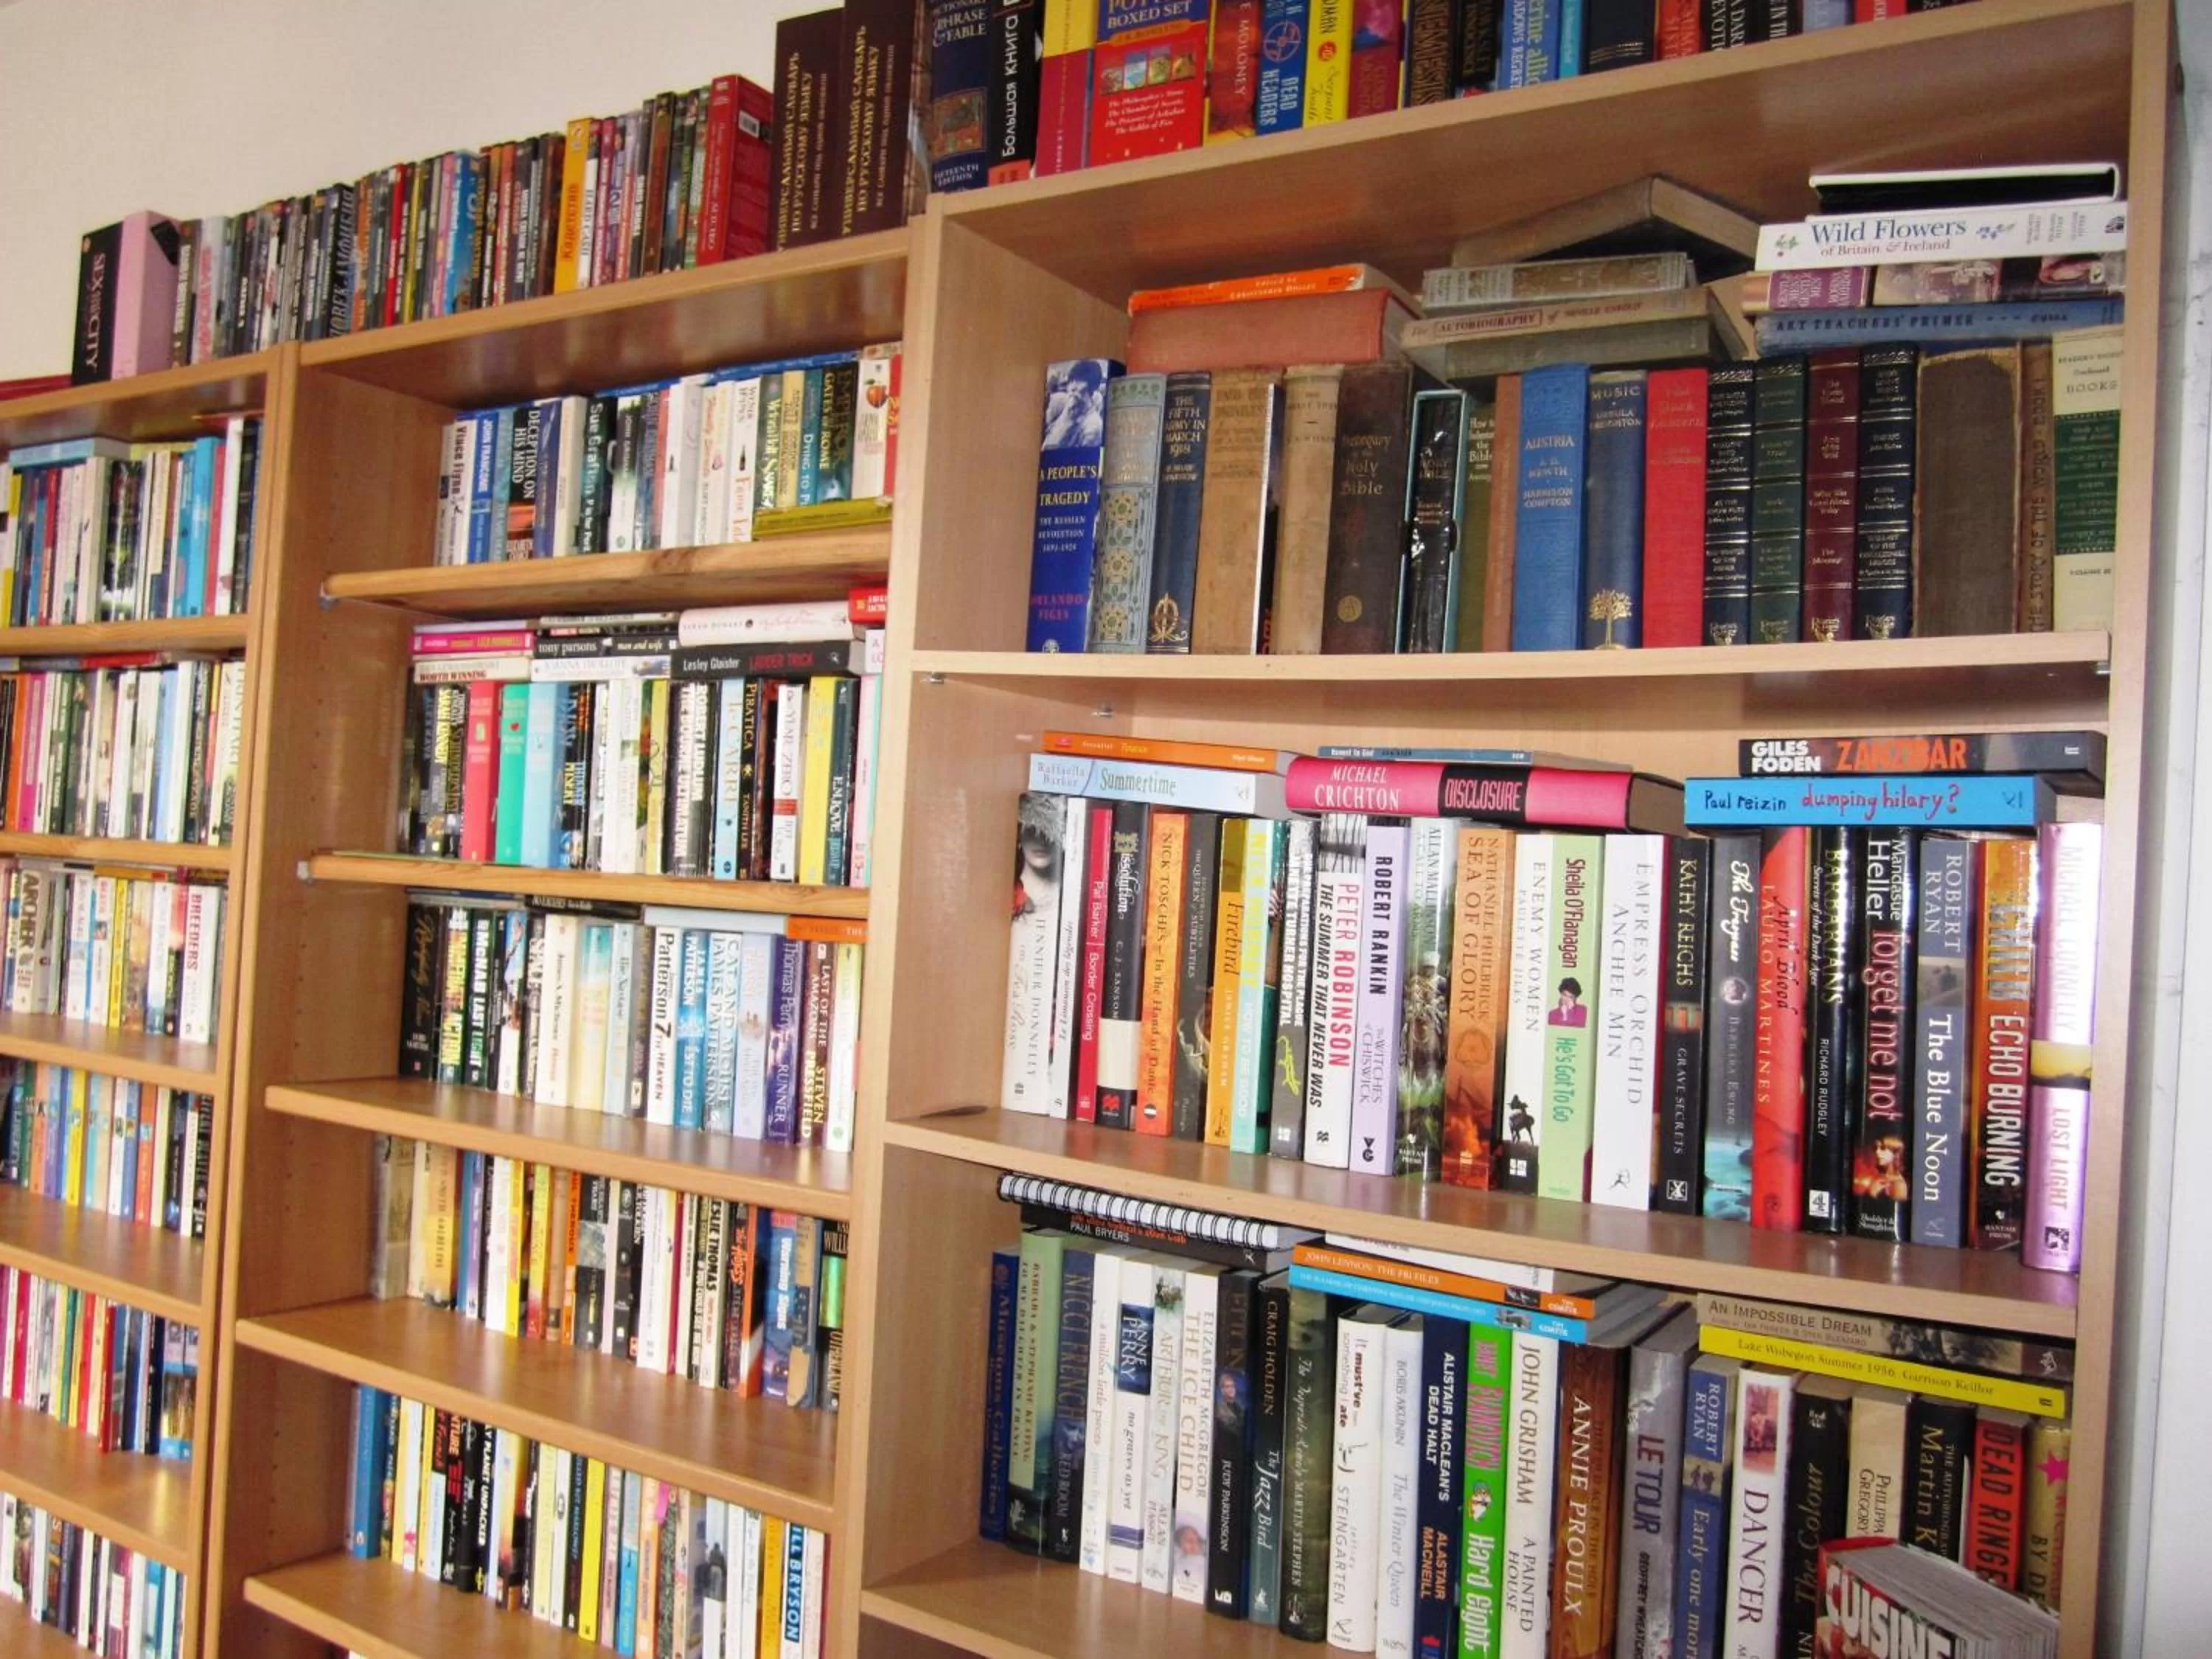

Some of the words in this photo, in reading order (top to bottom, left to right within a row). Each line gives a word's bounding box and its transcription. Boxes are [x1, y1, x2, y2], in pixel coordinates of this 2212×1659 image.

[1107, 7, 1161, 29] BOXED
[1164, 1, 1192, 23] SET
[1234, 20, 1250, 96] MOLONEY
[1278, 77, 1299, 111] DEAD
[1810, 218, 1865, 244] Wild
[1875, 216, 1967, 240] Flowers
[1820, 244, 1834, 256] of
[1837, 243, 1879, 256] Britain
[1904, 238, 1951, 251] Ireland
[590, 404, 602, 432] Sue
[1590, 384, 1641, 400] MUSIC
[515, 428, 525, 448] HIS
[524, 410, 540, 478] DECEPTION
[1524, 434, 1575, 450] AUSTRIA
[513, 451, 524, 484] MIND
[524, 481, 535, 498] ON
[585, 436, 602, 495] Grafton
[1039, 490, 1090, 506] TRAGEDY
[682, 686, 694, 711] THE
[695, 685, 708, 739] ROBERT
[743, 684, 757, 750] PIRATICA
[678, 715, 692, 771] BOURNE
[1751, 740, 1808, 757] GILES
[1751, 756, 1820, 773] FODEN
[1836, 738, 1967, 773] ZANZIBAR
[692, 743, 706, 801] LUDLUM
[1099, 768, 1178, 797] Summertime
[1315, 783, 1401, 810] CRICHTON
[1331, 765, 1388, 782] MICHAEL
[1444, 778, 1523, 811] DISCLOSURE
[675, 773, 690, 857] ULTIMATUM
[1704, 789, 1731, 810] Paul
[1737, 793, 1787, 810] reizin
[1801, 783, 1877, 820] dumping
[1882, 782, 1960, 821] hilary?
[1467, 835, 1483, 883] SEA
[1484, 838, 1498, 930] NATHANIEL
[1564, 858, 1587, 897] Sheila
[1865, 840, 1889, 920] Heller
[1889, 840, 1906, 921] Mandasue
[1093, 881, 1104, 900] Pat
[1318, 883, 1333, 911] THE
[1335, 883, 1360, 940] PETER
[1464, 891, 1480, 925] OF
[1531, 861, 1545, 935] ENEMY
[1678, 858, 1697, 915] KATHY
[1923, 870, 1942, 933] RYAN
[1943, 855, 1963, 952] ROBERT
[1091, 902, 1102, 937] Barker
[1558, 899, 1585, 968] O'Flanagan
[1633, 863, 1654, 977] EMPRESS
[1761, 886, 1776, 964] LAURO
[1821, 849, 1848, 1004] BARBARIANS
[684, 936, 697, 1006] PATTERSON
[712, 937, 725, 997] JAMES
[782, 942, 799, 992] Thomas
[1088, 953, 1099, 990] Border
[1315, 914, 1331, 982] SUMMER
[1609, 904, 1630, 998] ANCHEE
[1677, 923, 1694, 986] REICHS
[1864, 931, 1910, 1012] forget
[655, 933, 674, 1019] Patterson
[821, 965, 830, 996] LAST
[1313, 985, 1327, 1020] THAT
[1459, 933, 1478, 1020] GLORY
[1478, 935, 1495, 1020] PHILBRICK
[1526, 948, 1542, 1032] WOMEN
[778, 996, 796, 1029] Perry
[818, 1021, 828, 1047] THE
[820, 998, 829, 1018] OF
[1082, 992, 1096, 1041] Crossing
[1329, 950, 1356, 1067] ROBINSON
[1928, 1014, 1951, 1050] The
[1310, 1024, 1325, 1071] NEVER
[1556, 1037, 1576, 1063] He's
[1607, 1012, 1624, 1059] MIN
[1627, 994, 1650, 1105] ORCHID
[1758, 979, 1773, 1104] MARTINES
[1818, 1038, 1830, 1084] RICHARD
[1869, 1020, 1898, 1065] me
[1989, 1015, 2024, 1077] ECHO
[775, 1064, 788, 1122] RUNNER
[802, 1051, 816, 1138] PRESSFIELD
[814, 1066, 826, 1123] STEVEN
[1310, 1073, 1323, 1107] WAS
[1359, 1032, 1374, 1104] CHISWICK
[1555, 1065, 1575, 1086] Got
[1676, 1048, 1687, 1093] GRAVE
[1552, 1105, 1573, 1122] Go
[1555, 1090, 1574, 1102] To
[1817, 1088, 1829, 1136] RUDGLEY
[1867, 1071, 1899, 1120] not
[1926, 1069, 1950, 1122] Blue
[1673, 1096, 1686, 1154] SECRETS
[1984, 1083, 2023, 1186] BURNING
[2051, 1107, 2072, 1150] LOST
[1923, 1133, 1950, 1202] Noon
[2047, 1159, 2070, 1211] LIGHT
[779, 1238, 792, 1291] Warning
[776, 1295, 789, 1329] Signs
[1184, 1312, 1200, 1357] THE
[1265, 1301, 1278, 1346] CRAIG
[1121, 1316, 1138, 1379] PERRY
[1135, 1319, 1149, 1366] ANNE
[1200, 1312, 1214, 1399] ELIZABETH
[1183, 1368, 1198, 1407] ICE
[1263, 1350, 1276, 1415] HOLDEN
[1441, 1352, 1455, 1415] ALISTAIR
[1520, 1344, 1540, 1403] JOHN
[1427, 1385, 1440, 1424] DEAD
[1692, 1392, 1707, 1439] RYAN
[1705, 1383, 1720, 1455] ROBERT
[1180, 1416, 1197, 1492] CHILD
[1197, 1405, 1211, 1499] McGREGOR
[1426, 1429, 1439, 1464] HALT
[1438, 1419, 1453, 1501] MACLEAN'S
[1516, 1410, 1537, 1503] GRISHAM
[1569, 1396, 1590, 1489] ANNIE
[1638, 1434, 1665, 1464] LE
[1917, 1425, 1944, 1516] Martin
[1294, 1481, 1306, 1528] MARTIN
[1634, 1470, 1663, 1534] TOUR
[1291, 1532, 1304, 1586] STEPHEN
[1332, 1485, 1349, 1604] STEINGARTEN
[1420, 1527, 1435, 1599] MACNEILL
[1434, 1531, 1448, 1599] ALASTAIR
[1467, 1534, 1494, 1587] Hard
[1523, 1537, 1537, 1548] A
[1564, 1500, 1588, 1615] PROULX
[1737, 1489, 1770, 1623] DANCER
[786, 1559, 801, 1641] BRYSON
[1506, 1551, 1520, 1613] HOUSE
[1520, 1555, 1534, 1632] PAINTED
[1461, 1594, 1495, 1652] Eight
